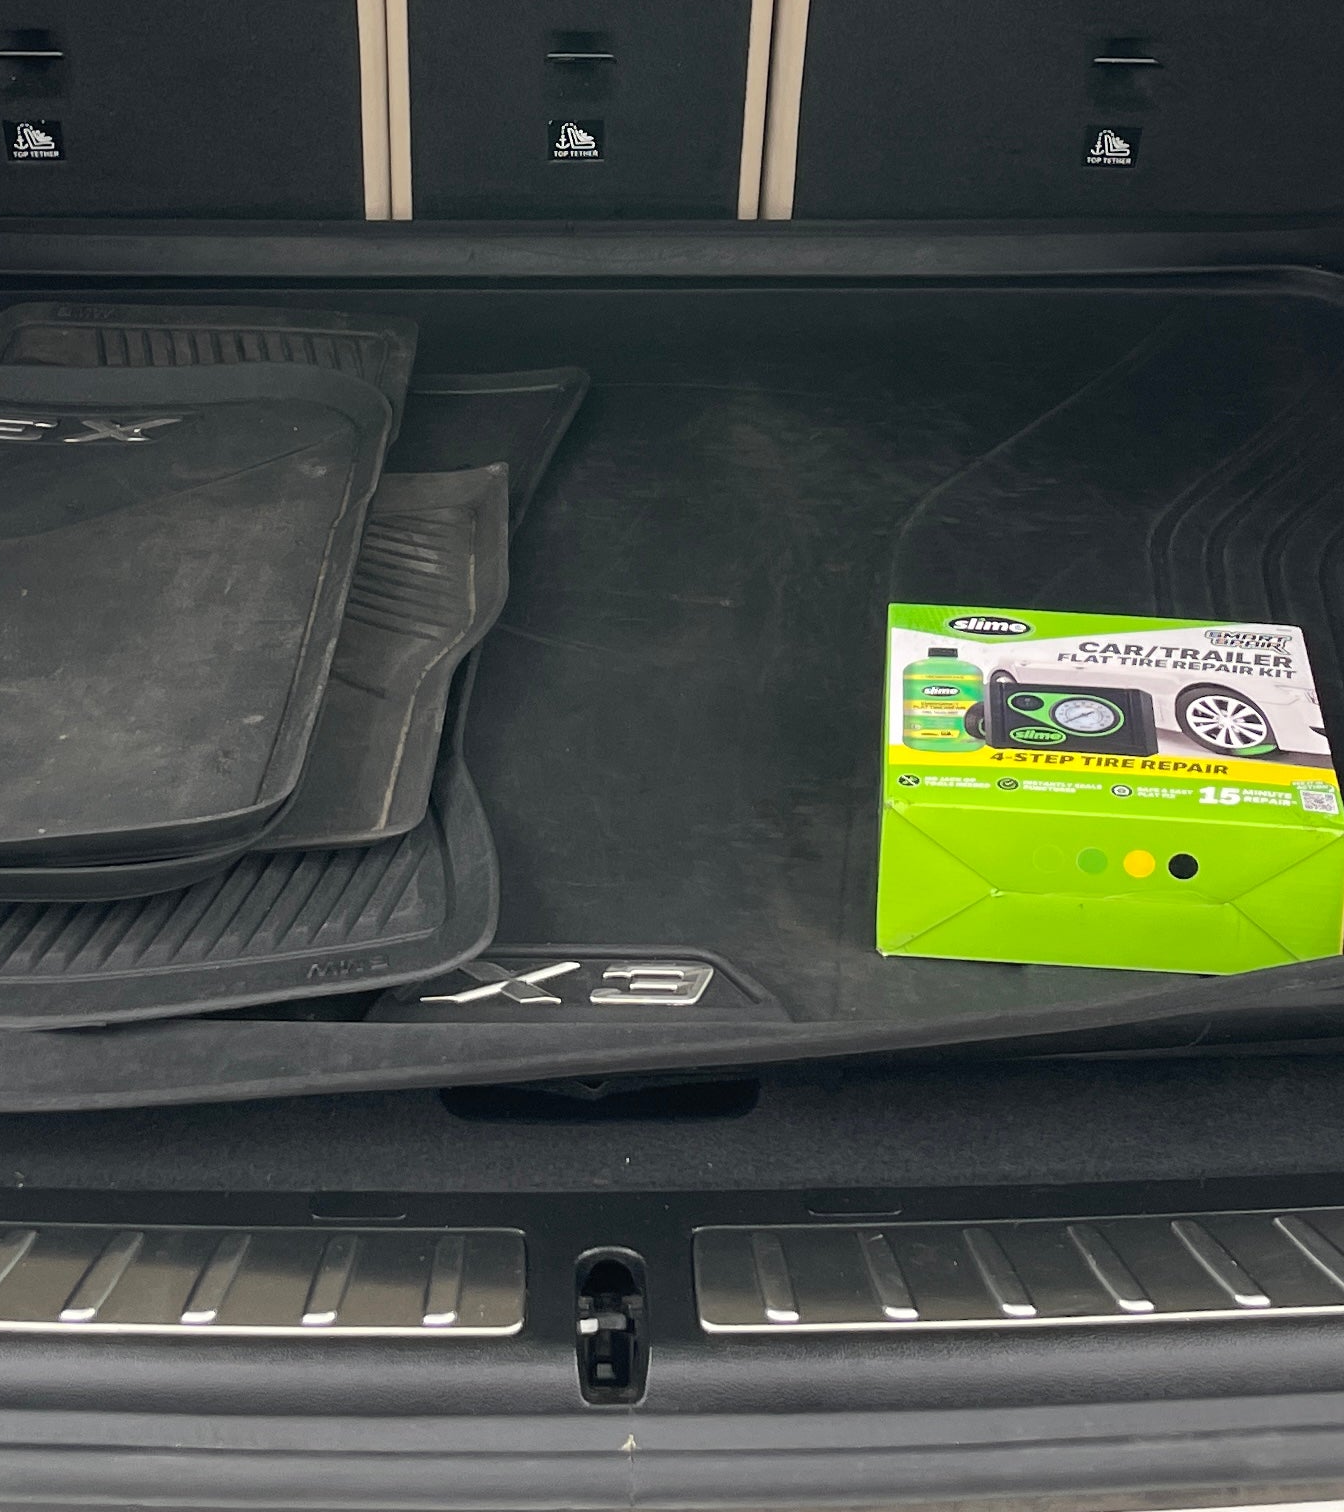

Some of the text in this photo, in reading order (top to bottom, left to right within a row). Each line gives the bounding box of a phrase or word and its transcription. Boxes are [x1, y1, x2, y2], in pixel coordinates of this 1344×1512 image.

[570, 150, 599, 158] TETHER
[953, 617, 1027, 633] slime
[1078, 641, 1293, 669] CAR/TRAILER
[1057, 652, 1297, 679] FLAT TIRE REPAIR KIT
[1016, 729, 1063, 741] slime
[990, 752, 1229, 775] 4-STEP TIRE REPAIR
[1198, 787, 1241, 805] 15
[1242, 789, 1292, 799] MINUTE
[419, 961, 714, 1005] X3
